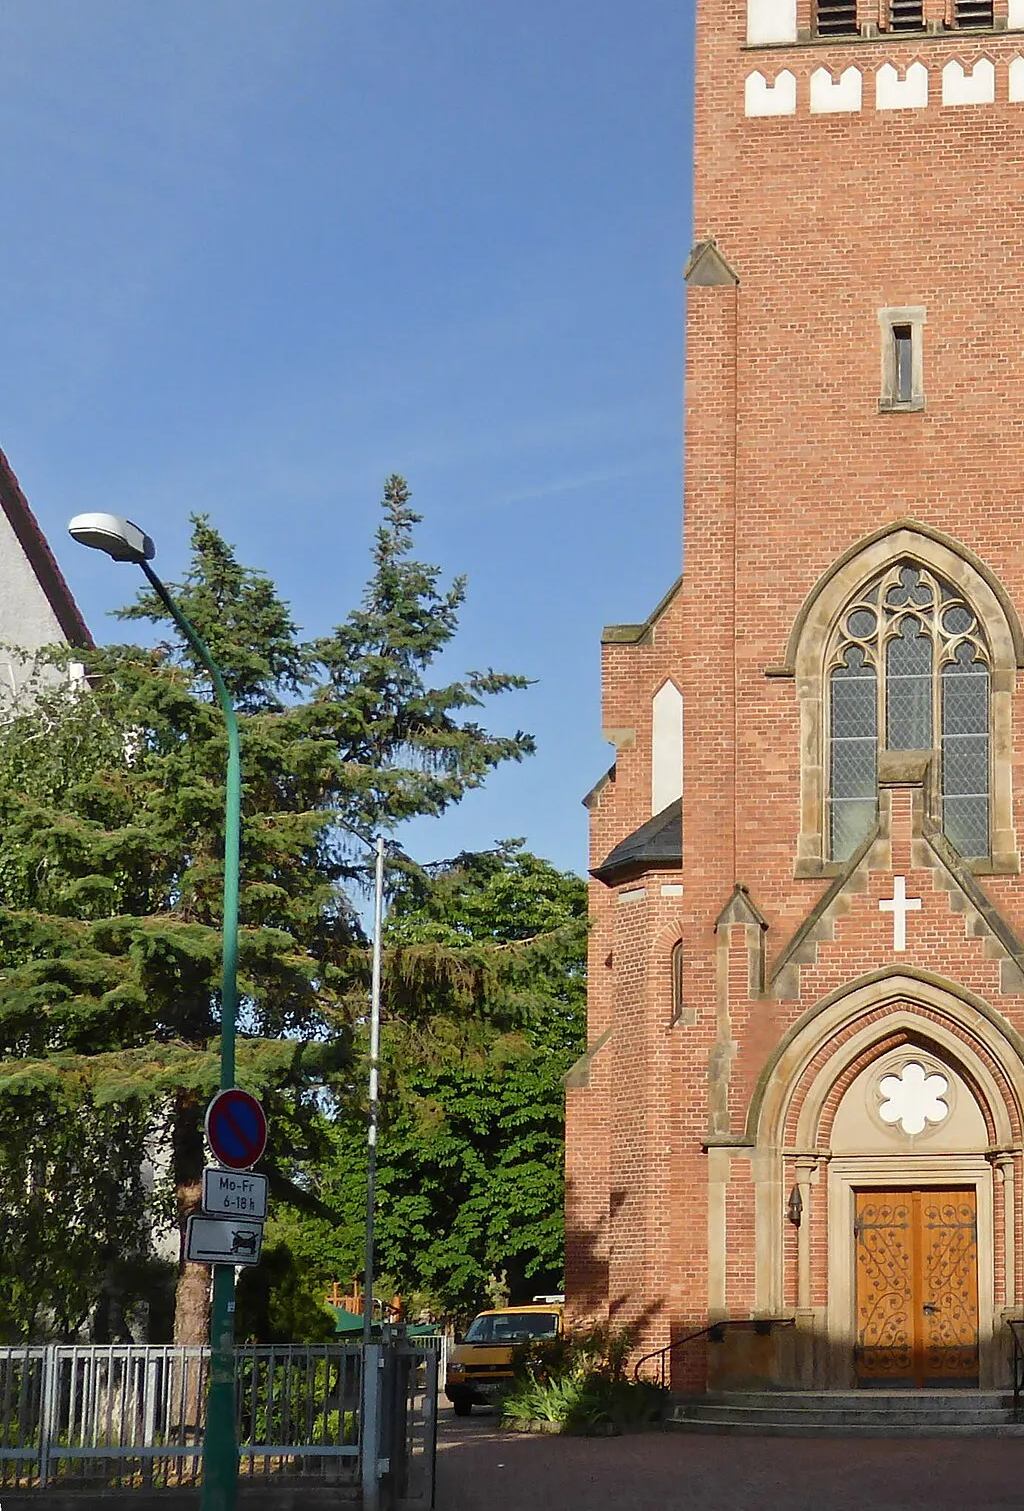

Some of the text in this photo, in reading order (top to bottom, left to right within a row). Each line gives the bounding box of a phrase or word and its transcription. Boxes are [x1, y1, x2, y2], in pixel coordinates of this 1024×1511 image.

[219, 1177, 255, 1192] Mo-Fr
[223, 1195, 255, 1211] 6-18 h
